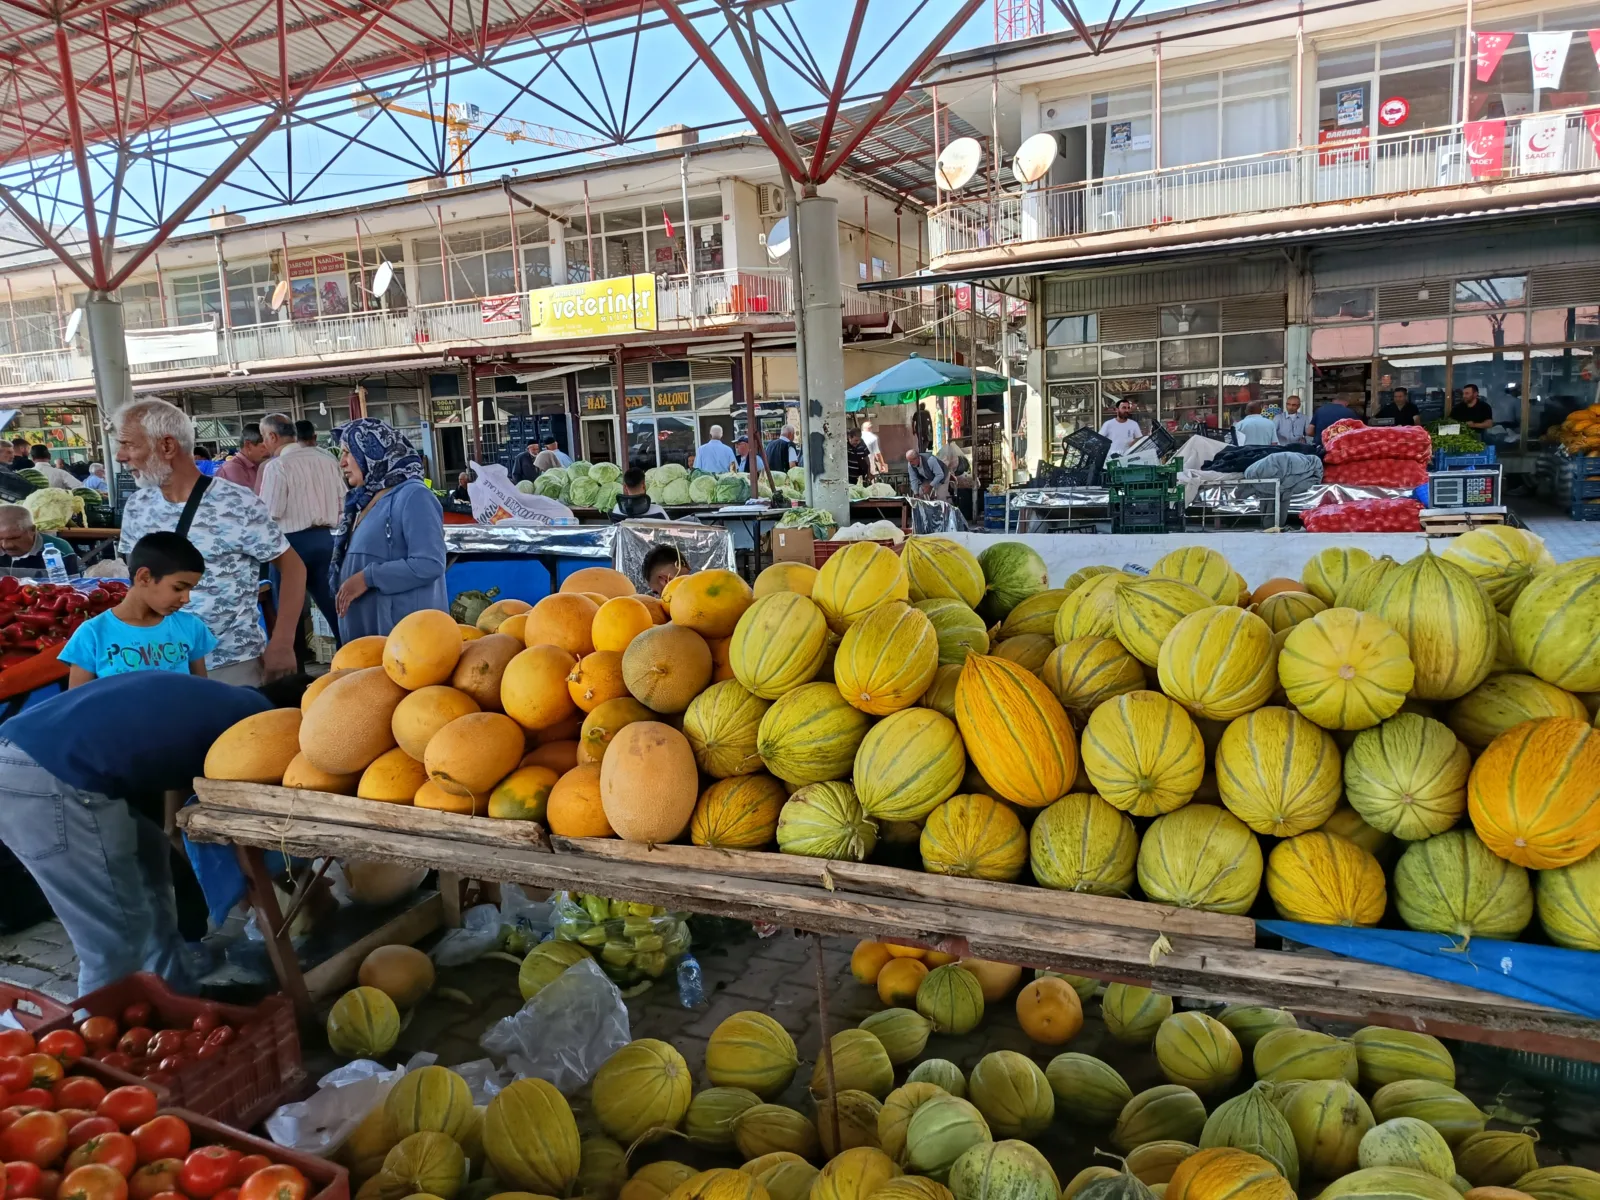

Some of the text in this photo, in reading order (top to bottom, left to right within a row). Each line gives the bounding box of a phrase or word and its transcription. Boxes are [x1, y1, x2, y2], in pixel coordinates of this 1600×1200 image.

[1525, 152, 1556, 160] SAADET
[552, 287, 651, 320] veteriner
[587, 397, 606, 410] HAL
[657, 391, 690, 406] SALONU
